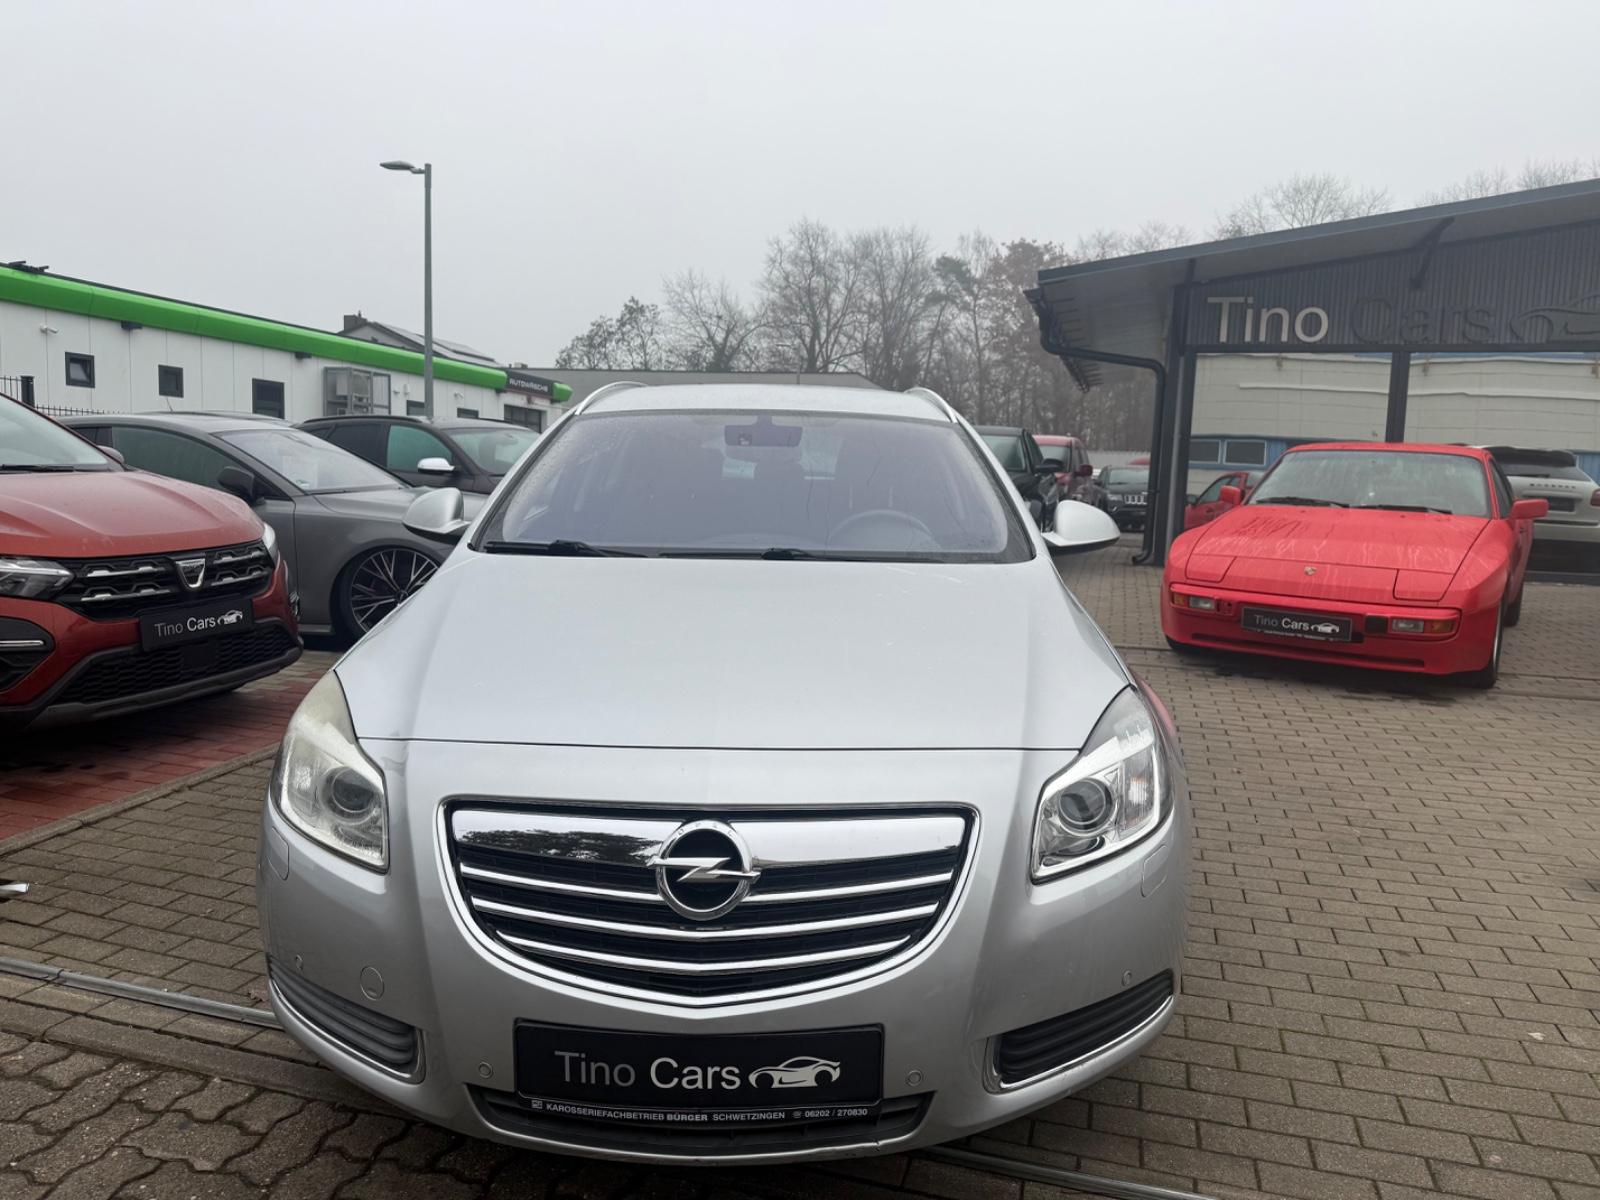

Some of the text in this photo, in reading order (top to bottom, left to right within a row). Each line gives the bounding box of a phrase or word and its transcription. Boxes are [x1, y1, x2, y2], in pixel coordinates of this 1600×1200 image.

[1207, 297, 1496, 343] Tino Cars
[154, 617, 216, 637] Tino Cars
[1254, 614, 1310, 631] Tino Cars
[554, 1050, 742, 1090] Tino Cars
[546, 1103, 665, 1121] KAROSSERIEFACHBETRIEB
[666, 1112, 708, 1122] BÜRGER
[713, 1112, 786, 1122] SCHWETZINGEN
[805, 1109, 830, 1118] 06202
